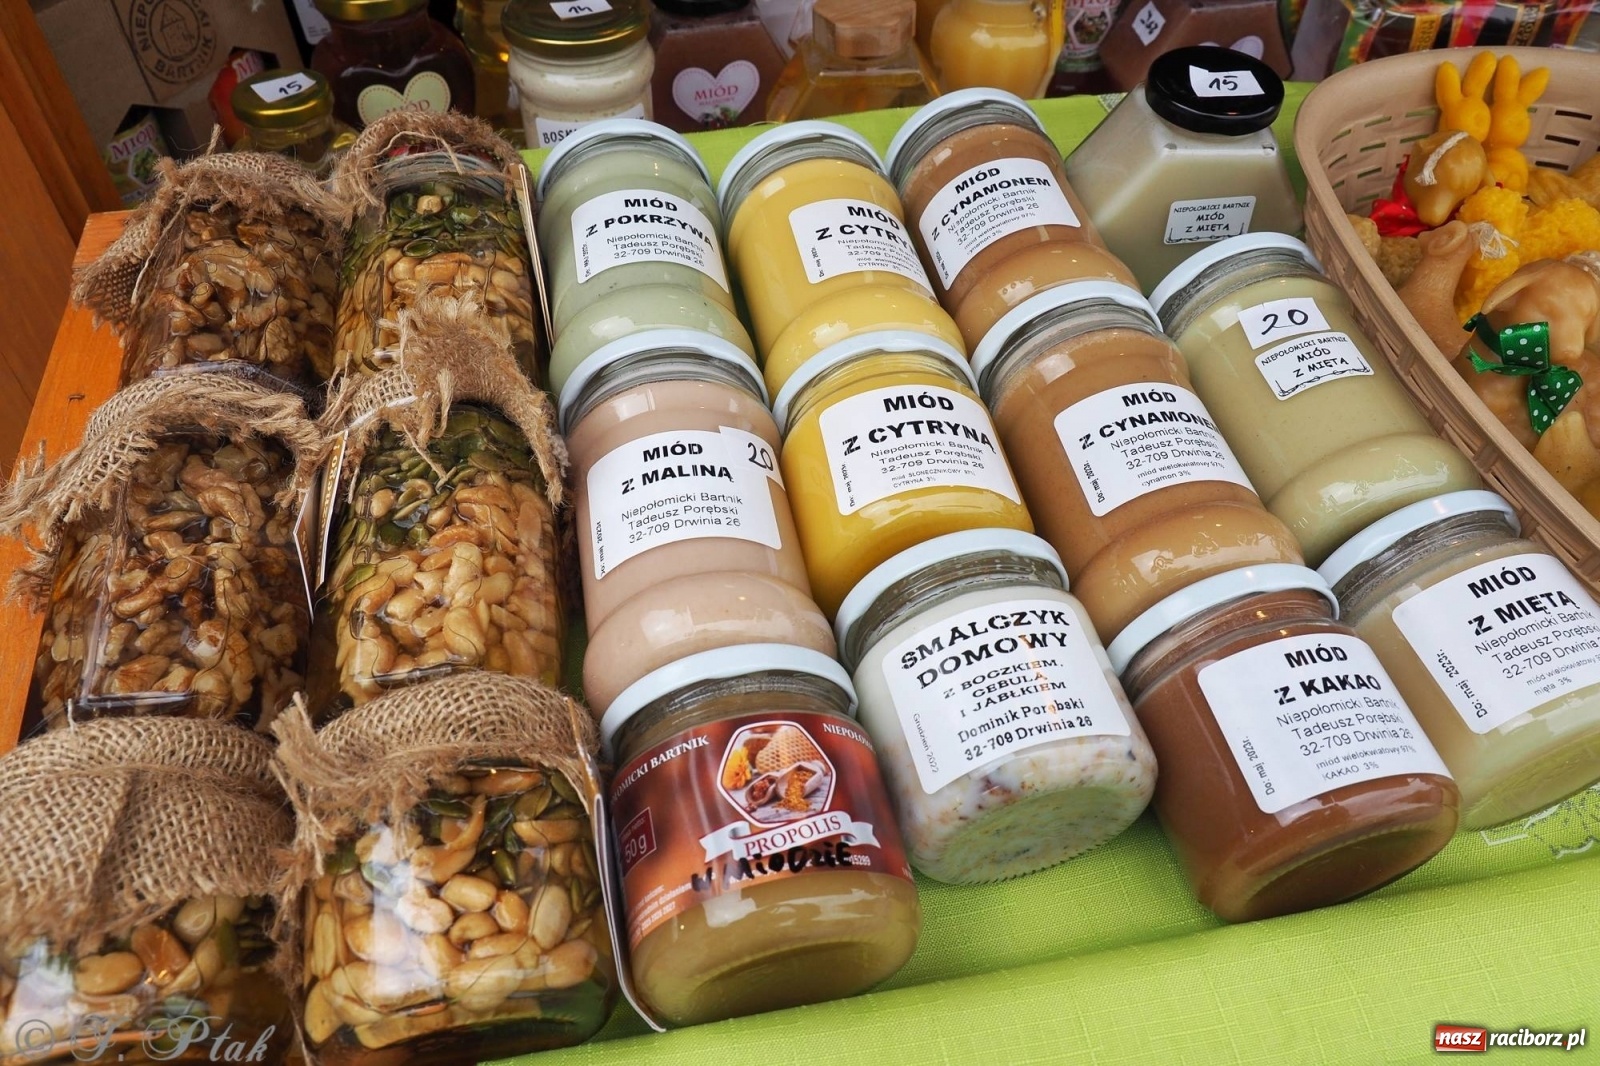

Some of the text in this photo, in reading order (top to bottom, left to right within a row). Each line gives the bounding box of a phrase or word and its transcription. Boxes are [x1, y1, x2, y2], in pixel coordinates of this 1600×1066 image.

[279, 81, 302, 94] 15
[694, 85, 738, 101] MIÓD
[1209, 76, 1238, 91] 15
[955, 167, 1000, 194] MIÓD
[1002, 188, 1036, 198] Bartnik
[624, 197, 677, 211] MIÓD
[931, 177, 1051, 241] Z CYNAMONEM
[1196, 212, 1224, 221] MIÓD
[586, 224, 598, 238] Z
[847, 206, 900, 230] MIÓD
[954, 209, 990, 237] Tadeusz
[957, 221, 986, 245] 32-709
[988, 206, 1024, 221] Drwinia
[613, 241, 658, 250] Tadeusz
[816, 227, 832, 240] Z
[614, 250, 650, 259] 32-709
[654, 248, 691, 260] Drwinia
[1261, 309, 1308, 335] 20
[1261, 337, 1348, 366] NIEPOŁOMICKI BARTNIK
[1297, 347, 1331, 363] MIÓD
[1293, 368, 1304, 378] Z
[883, 392, 954, 413] MIÓD
[1121, 389, 1177, 407] MIÓD
[642, 440, 703, 462] MIÓD
[842, 420, 997, 456] Z CYTRYNĄ
[870, 440, 984, 459] Niepołomicki Bartnik
[1079, 434, 1095, 450] Z
[1110, 428, 1183, 451] Niepołomicki
[1120, 439, 1173, 459] Tadeusz
[747, 442, 774, 472] 20
[879, 448, 981, 465] Tadeusz Porębski
[880, 457, 985, 474] 32-709 Drwinia 26
[1125, 452, 1169, 470] 32-709
[1171, 449, 1212, 458] Drwinia
[621, 464, 735, 495] Z MALINĄ
[893, 477, 924, 489] CYTRYNA
[621, 492, 743, 522] Niepołomicki Bartnik
[628, 505, 738, 531] Tadeusz Porębski
[629, 517, 741, 544] 32-709 Drwinia 26
[1467, 566, 1537, 599] MIÓD
[1468, 590, 1581, 636] Z MIĘTĄ
[1474, 609, 1595, 655] Niepołomicki Bartnik
[1491, 623, 1600, 664] Tadeusz Porębski
[916, 632, 1068, 690] DOMOWY
[1283, 643, 1348, 669] MIÓD
[1502, 640, 1598, 679] 32-709 Drwinia
[1273, 674, 1382, 706] Z KAKAO
[1436, 648, 1488, 718] Do: maj 2023r.
[1526, 674, 1546, 686] miód
[1534, 676, 1572, 696] mięta 3%
[944, 688, 956, 700] Z
[960, 681, 1067, 718] I JABŁKIEM
[958, 697, 1085, 744] Dominik Porębski
[1276, 696, 1399, 728] Niepołomicki Bartnik
[964, 715, 1093, 762] 32-709 Drwinia 26
[1291, 712, 1403, 740] Tadeusz Porębski
[650, 734, 710, 768] BARTNIK
[1299, 728, 1414, 758] 32-709 Drwinia 26
[1242, 735, 1275, 796] Do: maj 2023r.
[1322, 764, 1360, 782] KAKAO
[744, 814, 842, 858] PROPOLIS
